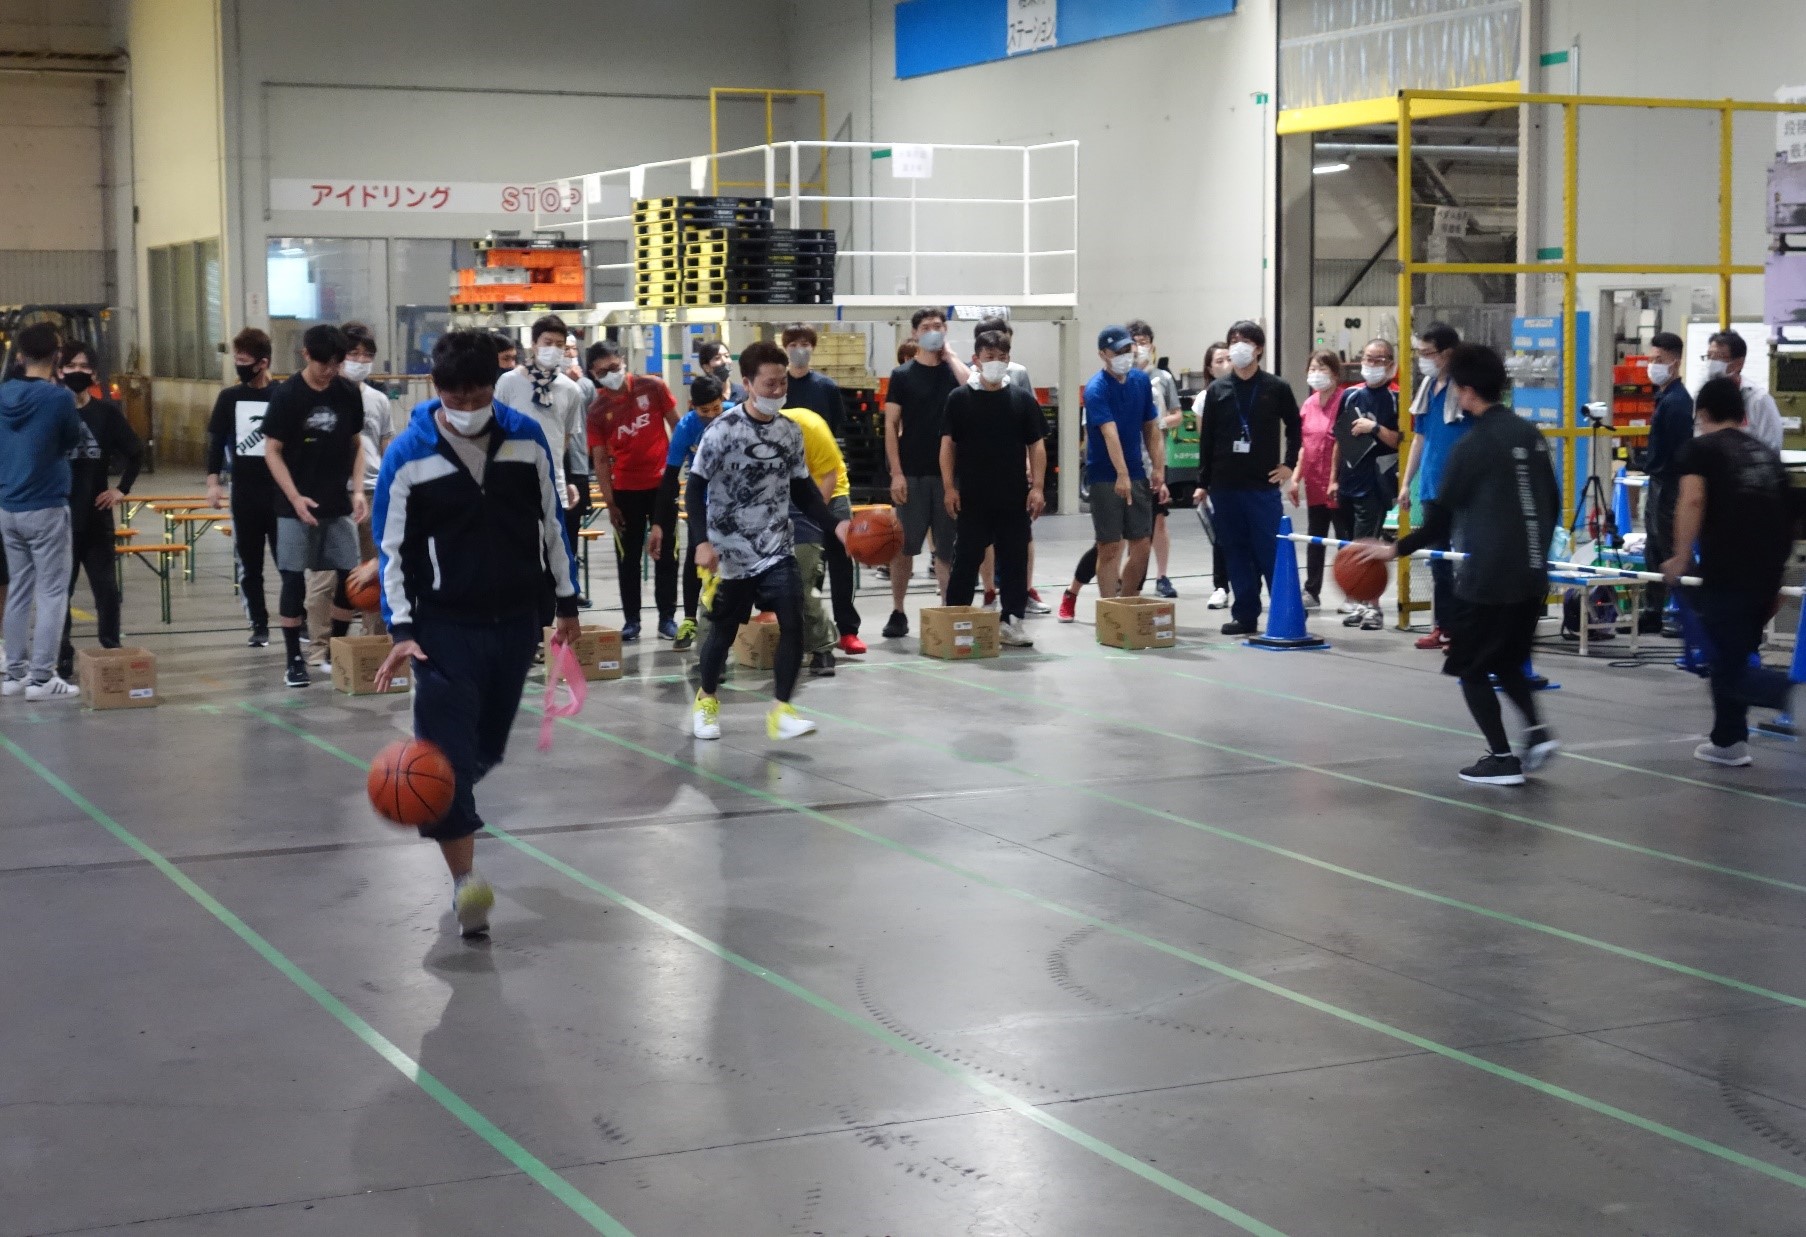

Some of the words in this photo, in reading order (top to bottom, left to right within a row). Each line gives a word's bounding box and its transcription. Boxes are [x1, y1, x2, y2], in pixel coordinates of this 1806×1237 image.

[311, 184, 450, 209] アイドリング
